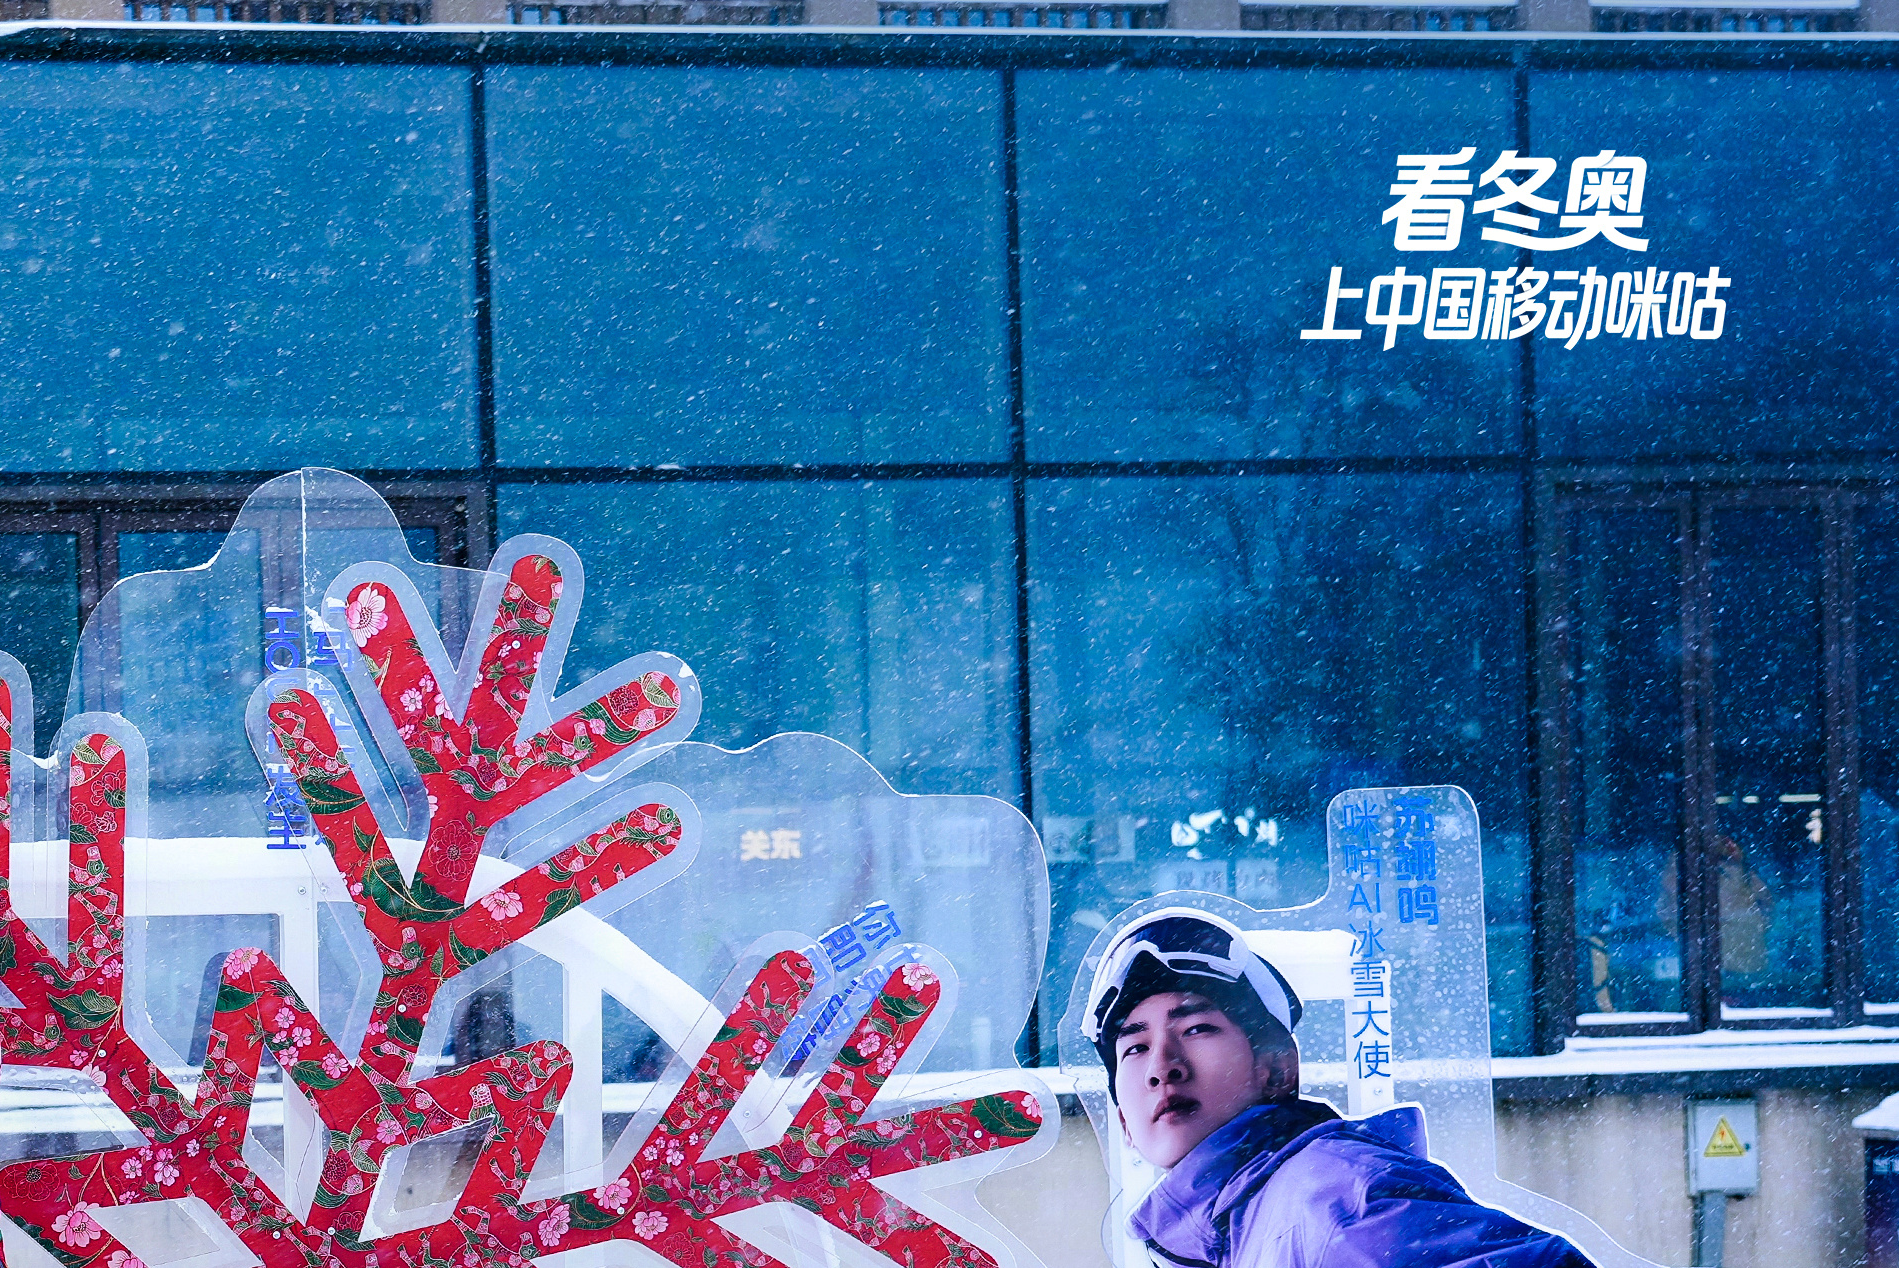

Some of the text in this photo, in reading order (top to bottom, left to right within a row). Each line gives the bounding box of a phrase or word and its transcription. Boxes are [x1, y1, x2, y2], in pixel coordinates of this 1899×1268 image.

[1343, 799, 1392, 1081] 咪咕AI冰雪大使
